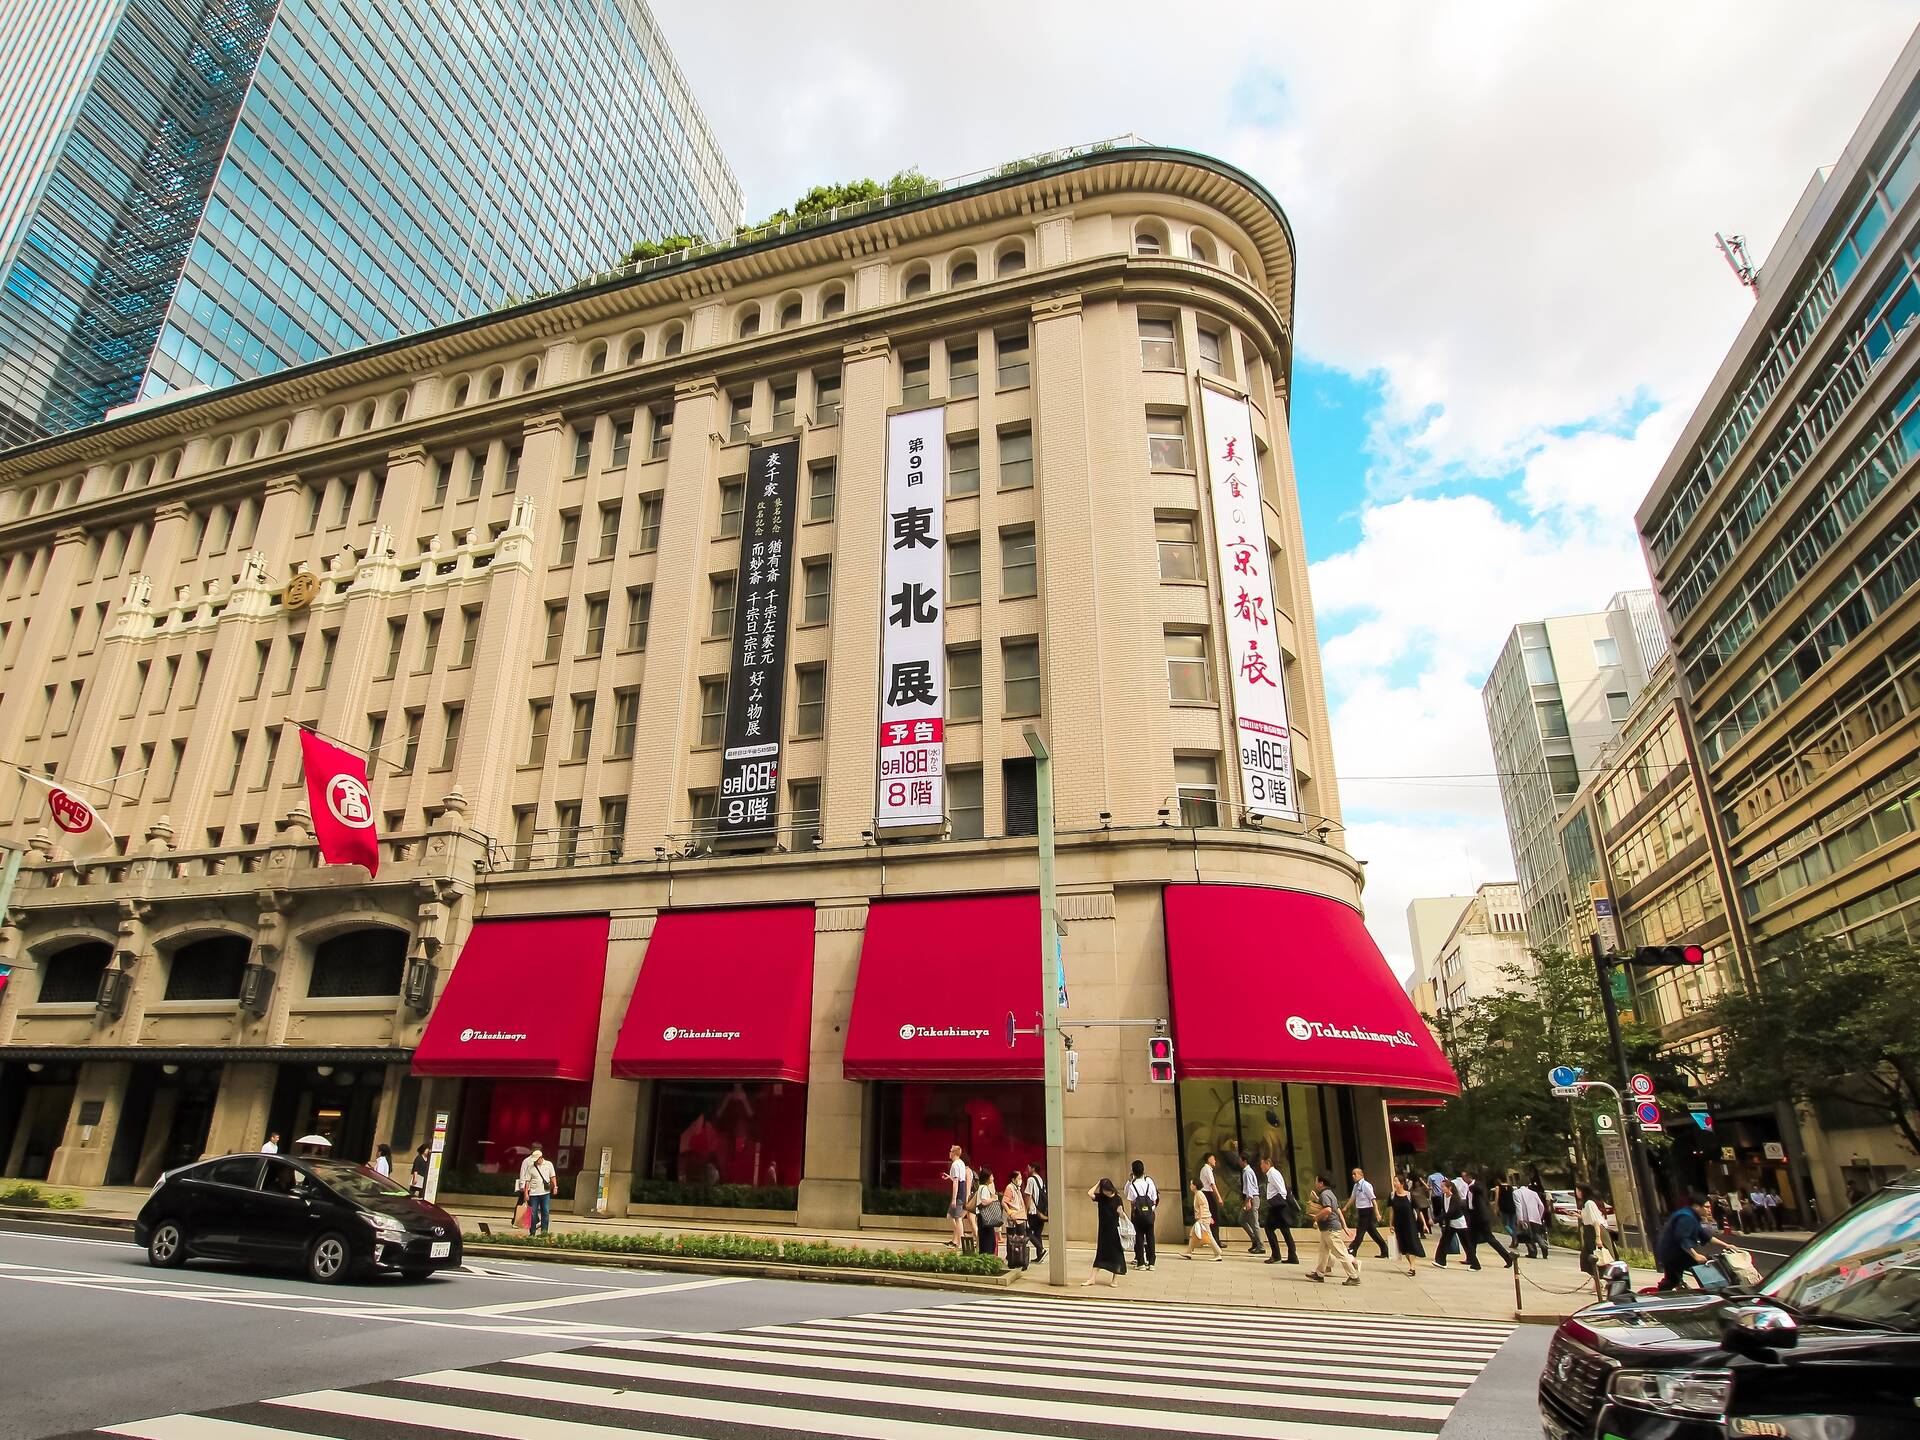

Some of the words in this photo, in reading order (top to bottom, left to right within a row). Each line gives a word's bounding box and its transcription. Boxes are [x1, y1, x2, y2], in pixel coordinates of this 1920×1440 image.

[763, 452, 782, 498] 表千家
[907, 437, 924, 488] 第9回
[886, 506, 940, 707] 東北展
[744, 670, 766, 737] 好み物展
[888, 721, 934, 744] 予告
[881, 749, 928, 776] 9月18日
[1242, 738, 1284, 772] 9月16日
[723, 761, 771, 795] 9月16日
[1251, 775, 1288, 807] 8階
[887, 780, 933, 807] 8階
[727, 796, 769, 825] 8階
[473, 1031, 527, 1042] Takashimaya
[678, 1028, 740, 1041] Takashimaya
[916, 1026, 990, 1039] Takashimaya
[1310, 1022, 1400, 1047] Takashimaya
